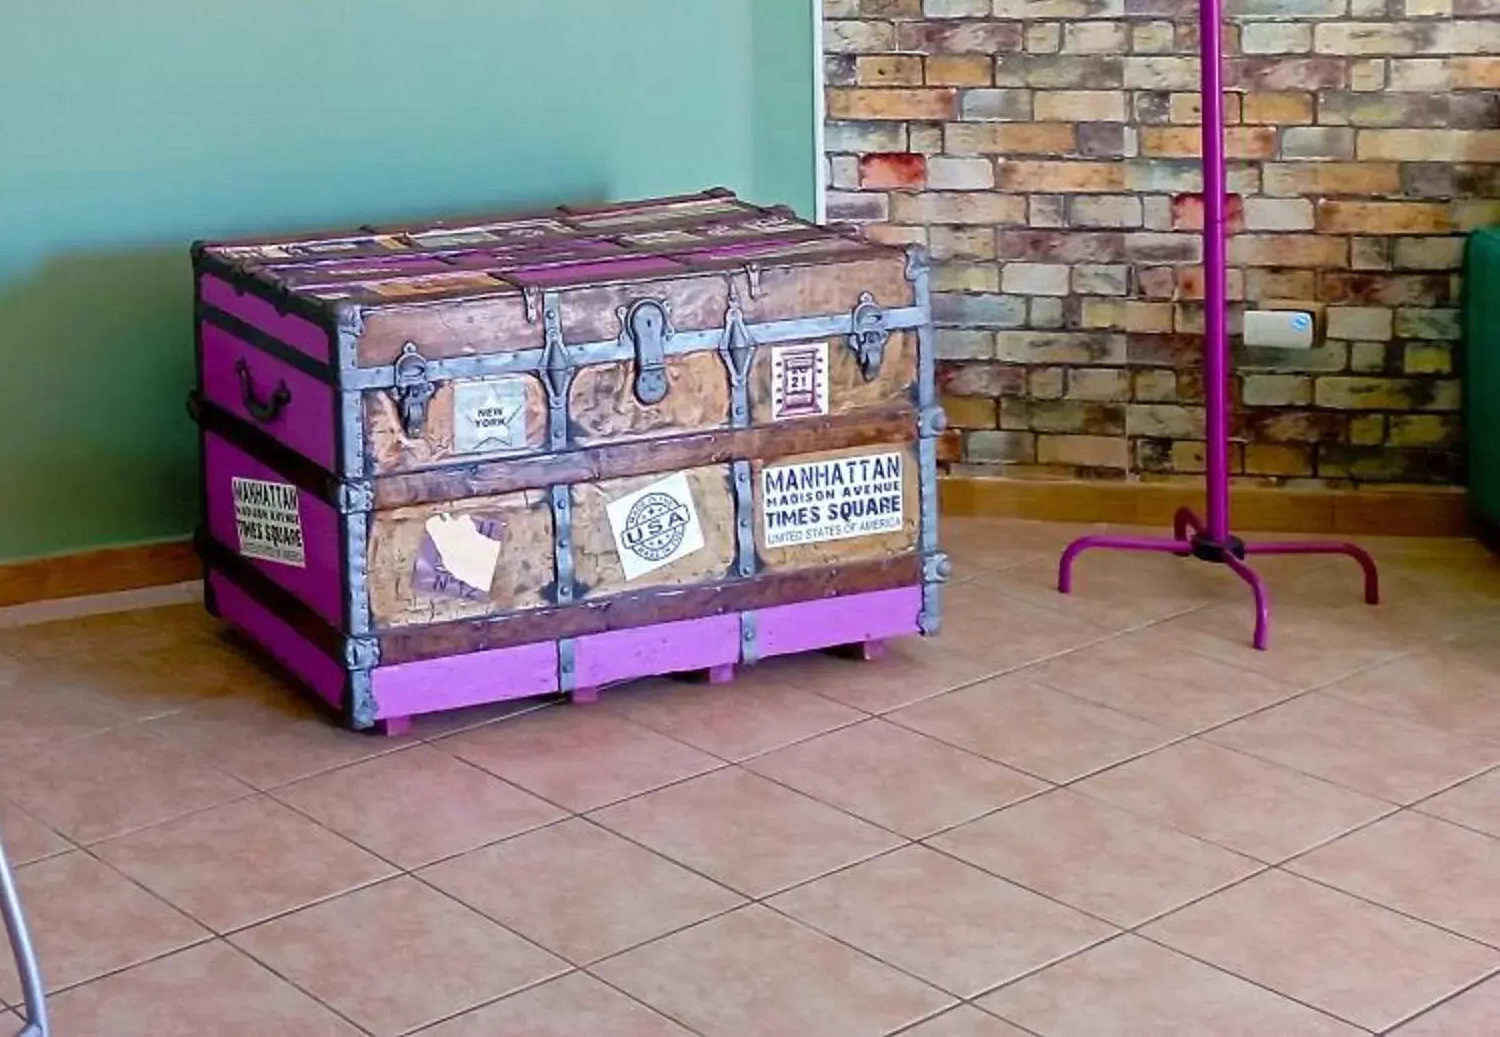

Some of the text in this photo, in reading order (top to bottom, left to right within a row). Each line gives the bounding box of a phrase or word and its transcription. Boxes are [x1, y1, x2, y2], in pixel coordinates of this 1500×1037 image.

[791, 376, 807, 388] 21
[475, 417, 507, 428] YORK
[477, 406, 504, 417] NEW
[765, 454, 901, 495] MANHATTAN
[767, 480, 901, 508] MADISON AVENUE
[766, 495, 901, 529] TIMES SQUARE
[627, 512, 685, 544] USA
[805, 524, 841, 540] STATES
[860, 518, 901, 533] AMERICA
